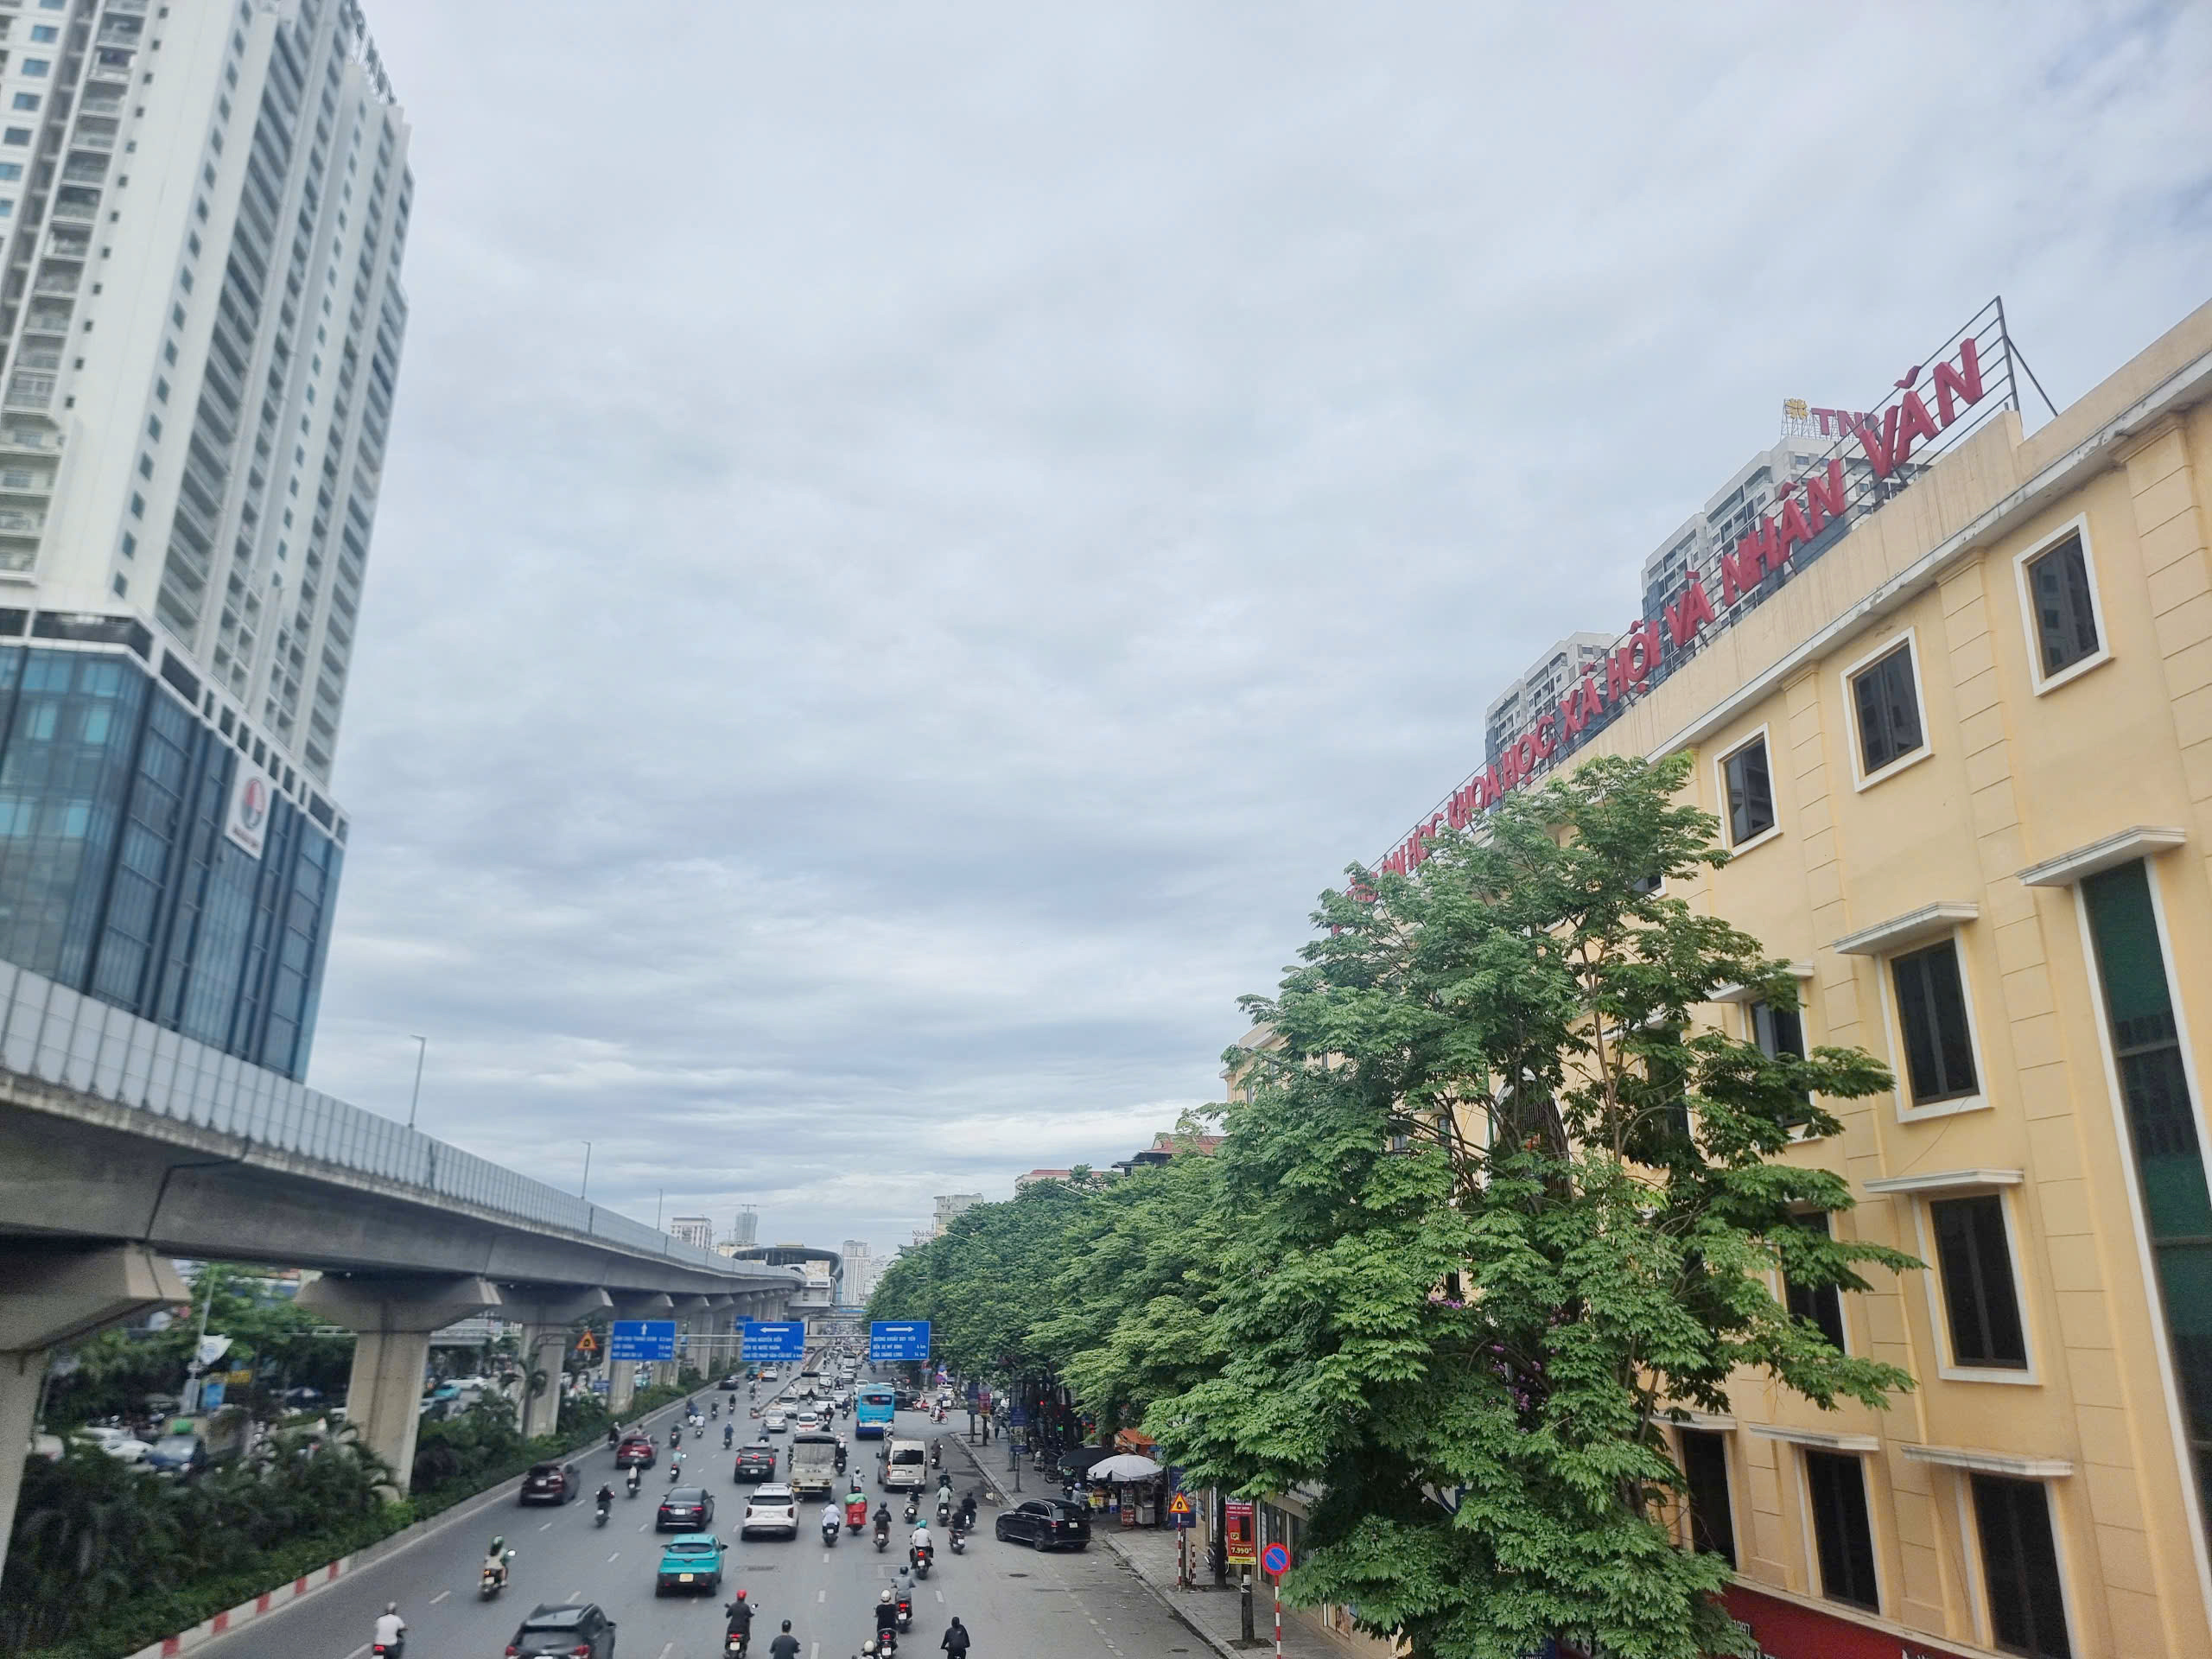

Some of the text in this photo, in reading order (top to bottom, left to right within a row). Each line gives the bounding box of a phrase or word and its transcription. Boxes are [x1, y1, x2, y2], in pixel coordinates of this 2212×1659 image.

[1447, 764, 1502, 831] KHOA
[1502, 715, 1556, 790] HỌC
[1559, 662, 1604, 741] XÃ
[1606, 620, 1662, 702] HỘI
[1664, 570, 1715, 648] VÀ
[1721, 458, 1846, 607] NHÂN
[1859, 337, 1984, 479] VĂN
